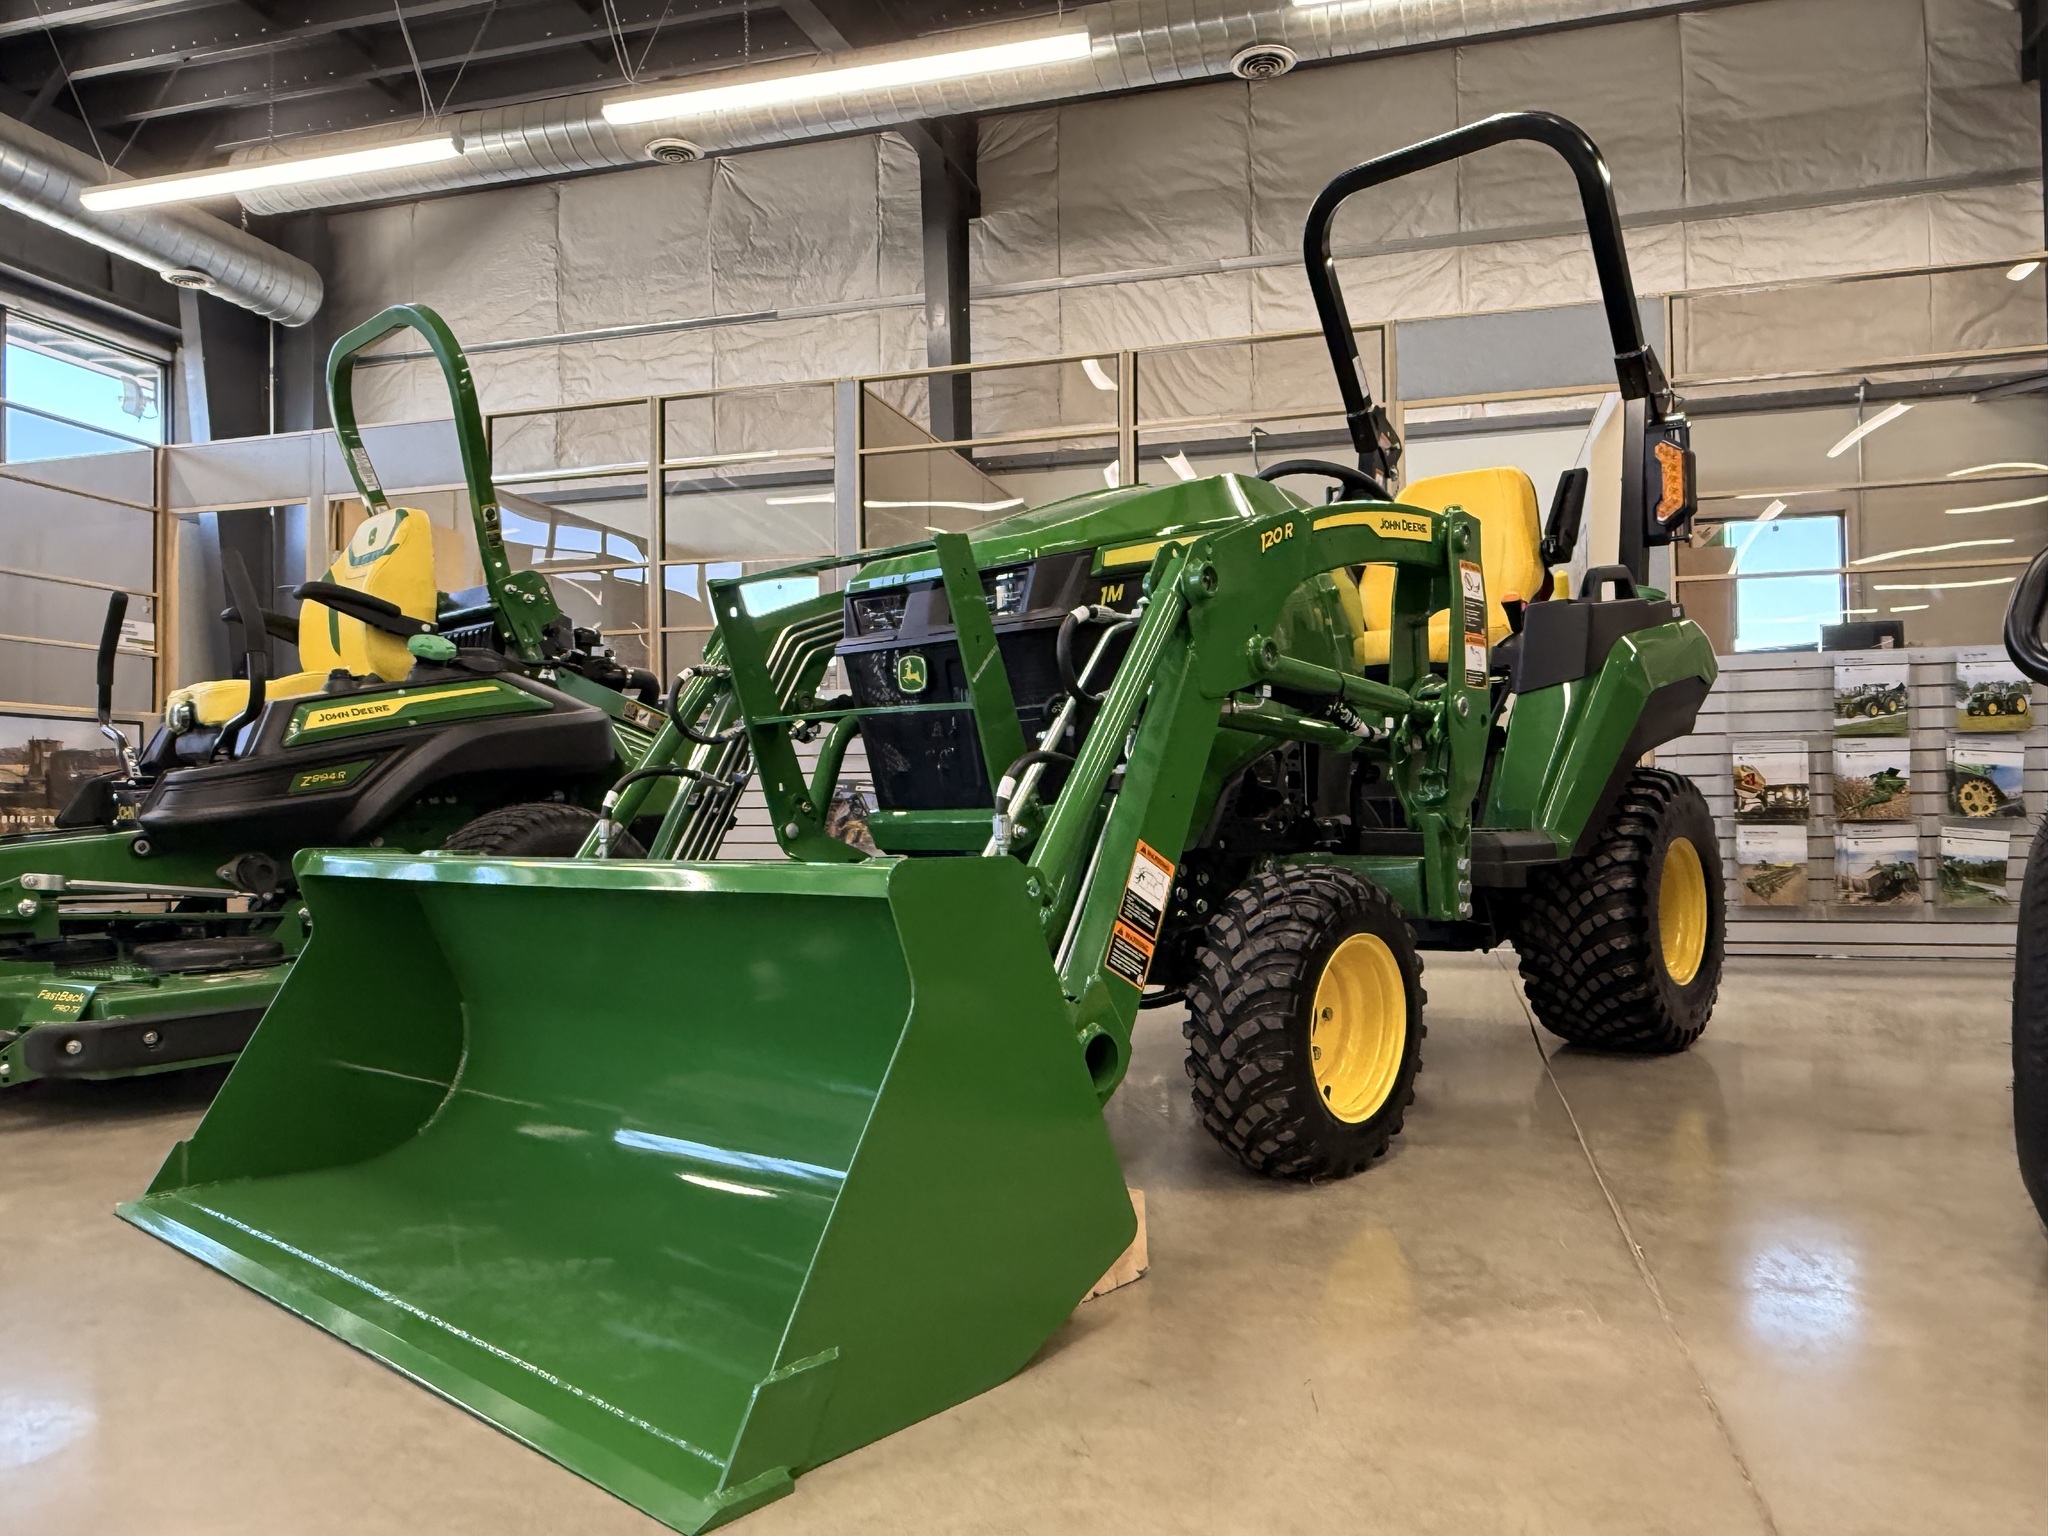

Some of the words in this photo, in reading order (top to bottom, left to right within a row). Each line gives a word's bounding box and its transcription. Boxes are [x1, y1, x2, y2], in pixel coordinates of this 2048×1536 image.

[1380, 517, 1401, 531] JOHN
[1402, 519, 1428, 533] DEERE
[1101, 583, 1125, 607] 1M
[318, 711, 350, 722] JOHN
[351, 704, 391, 718] DEERE
[37, 989, 85, 1003] FastBack
